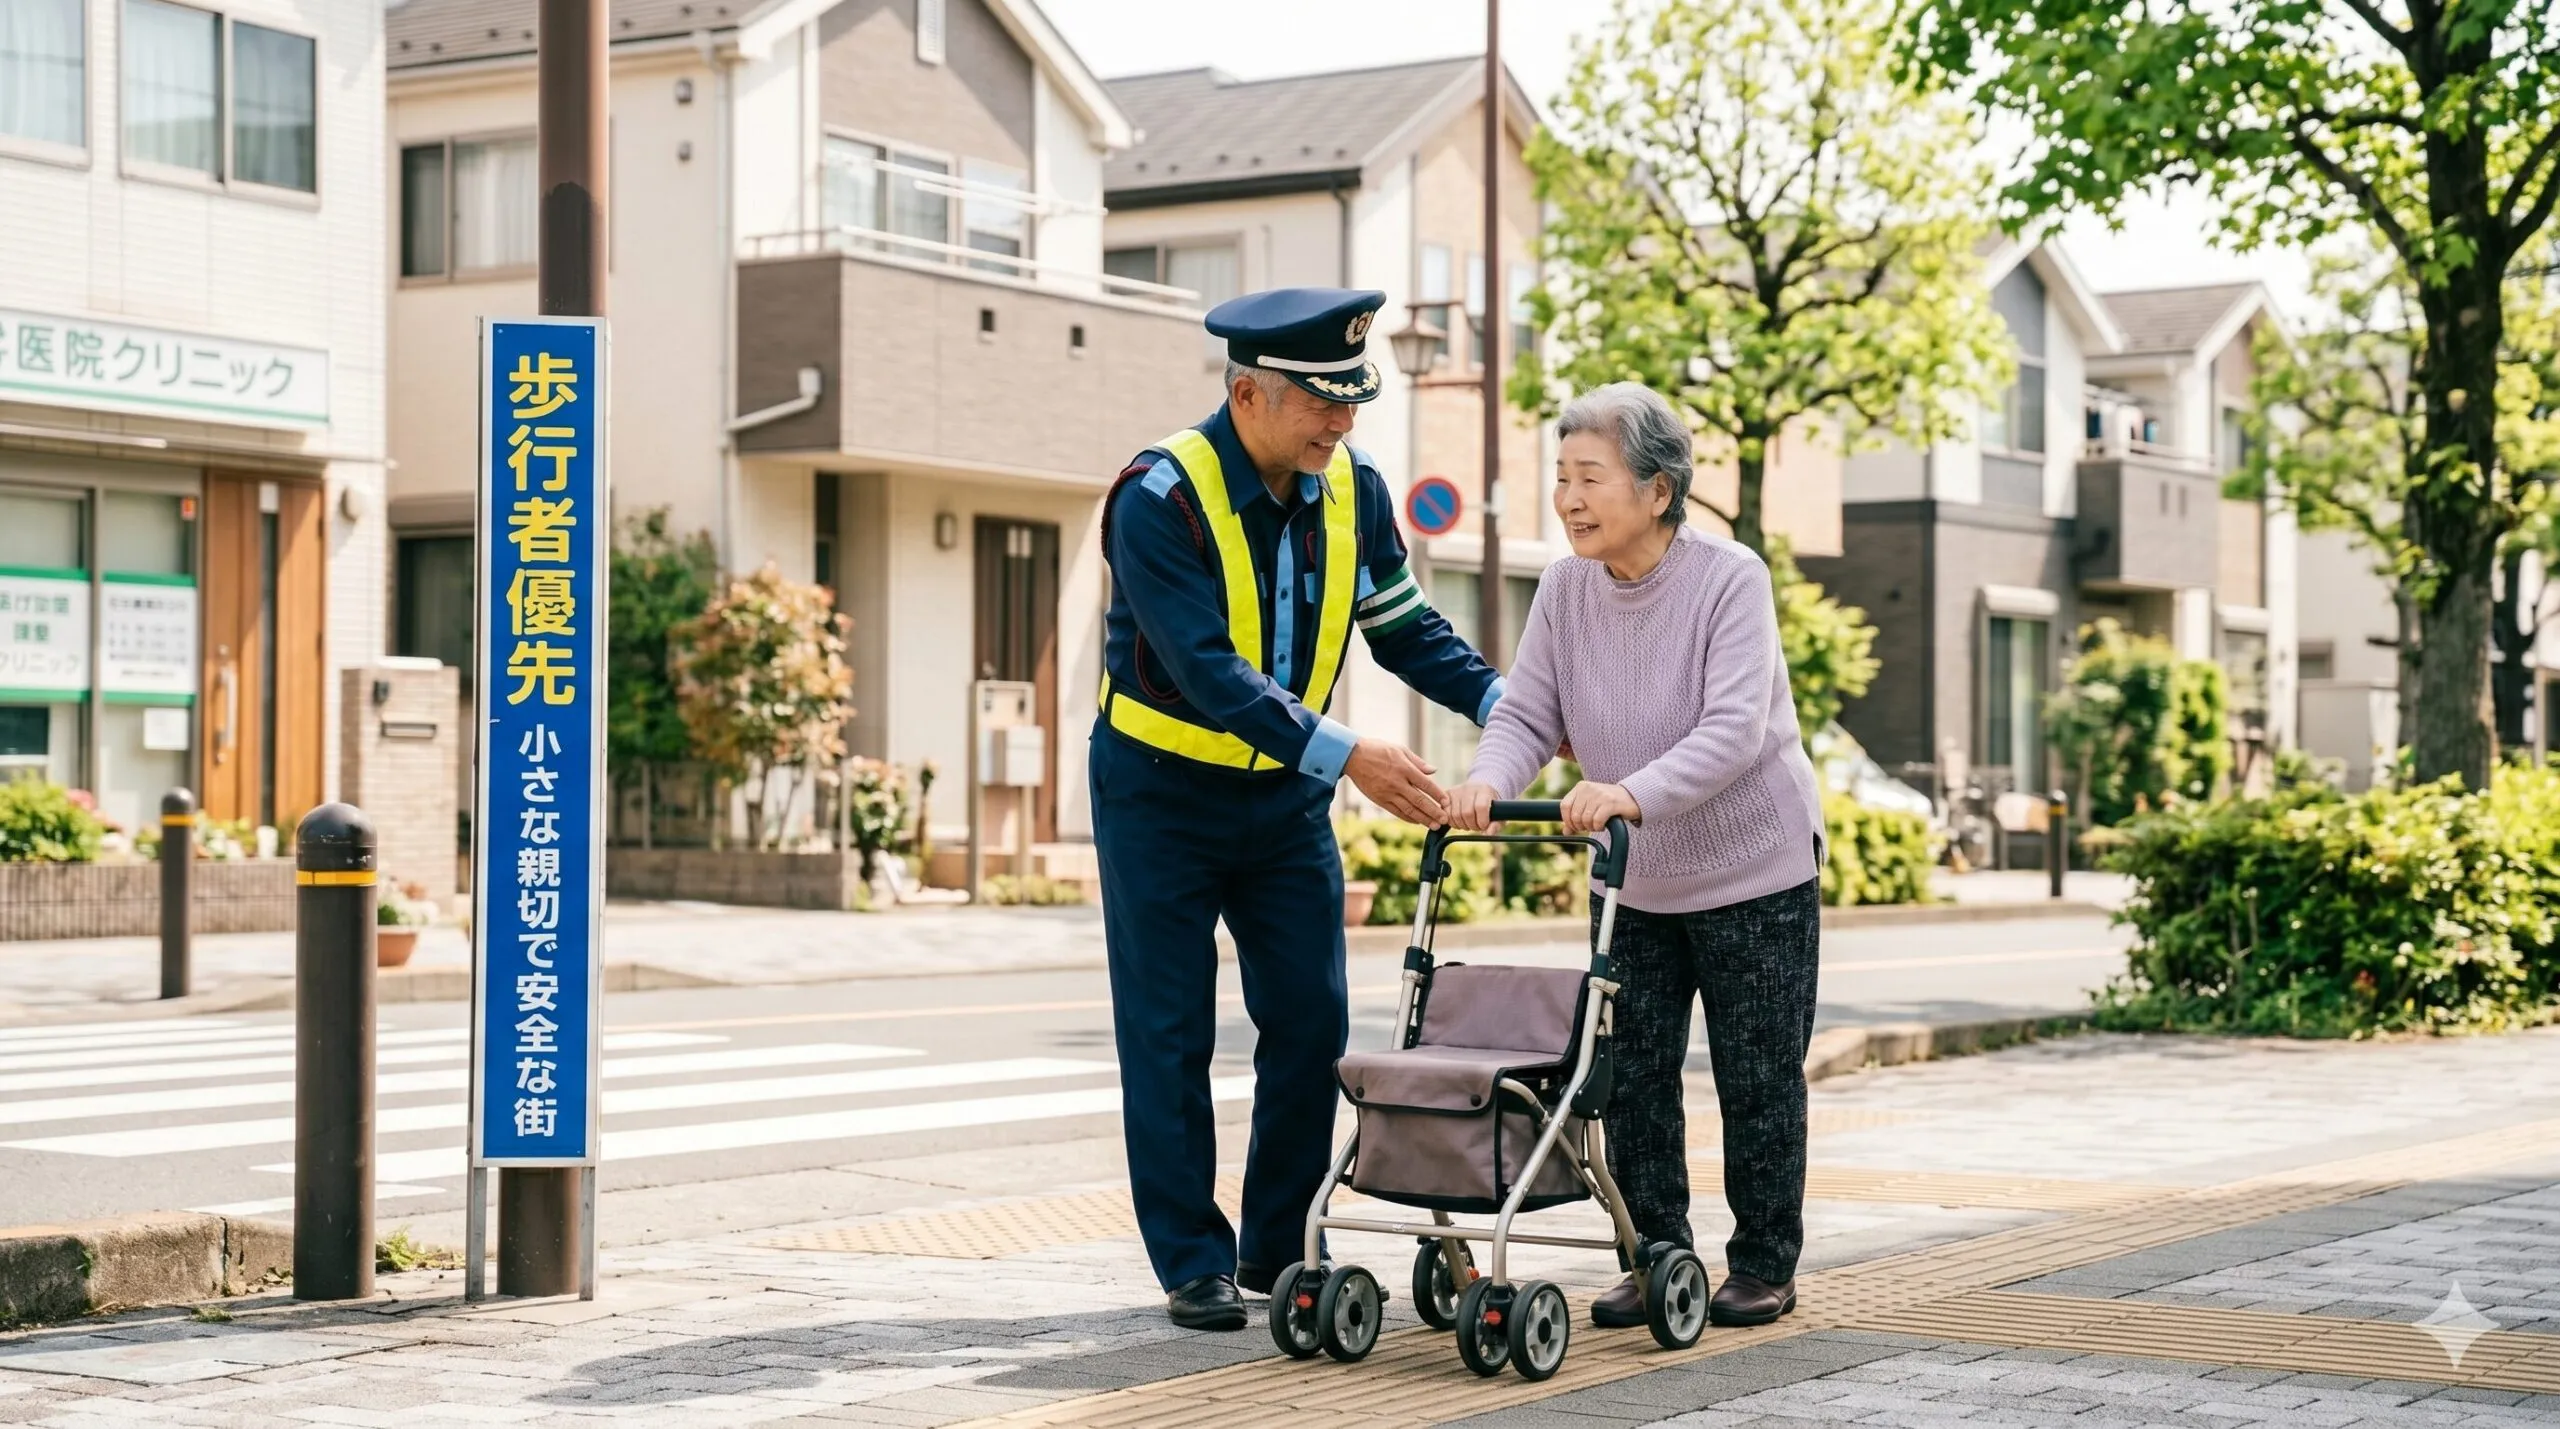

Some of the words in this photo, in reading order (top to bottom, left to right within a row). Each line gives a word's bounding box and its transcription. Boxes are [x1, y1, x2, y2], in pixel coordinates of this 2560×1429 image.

[0, 324, 293, 398] 医院クリニック
[506, 352, 578, 705] 歩行者優先
[513, 723, 562, 1137] 小さな親切で安全な街
